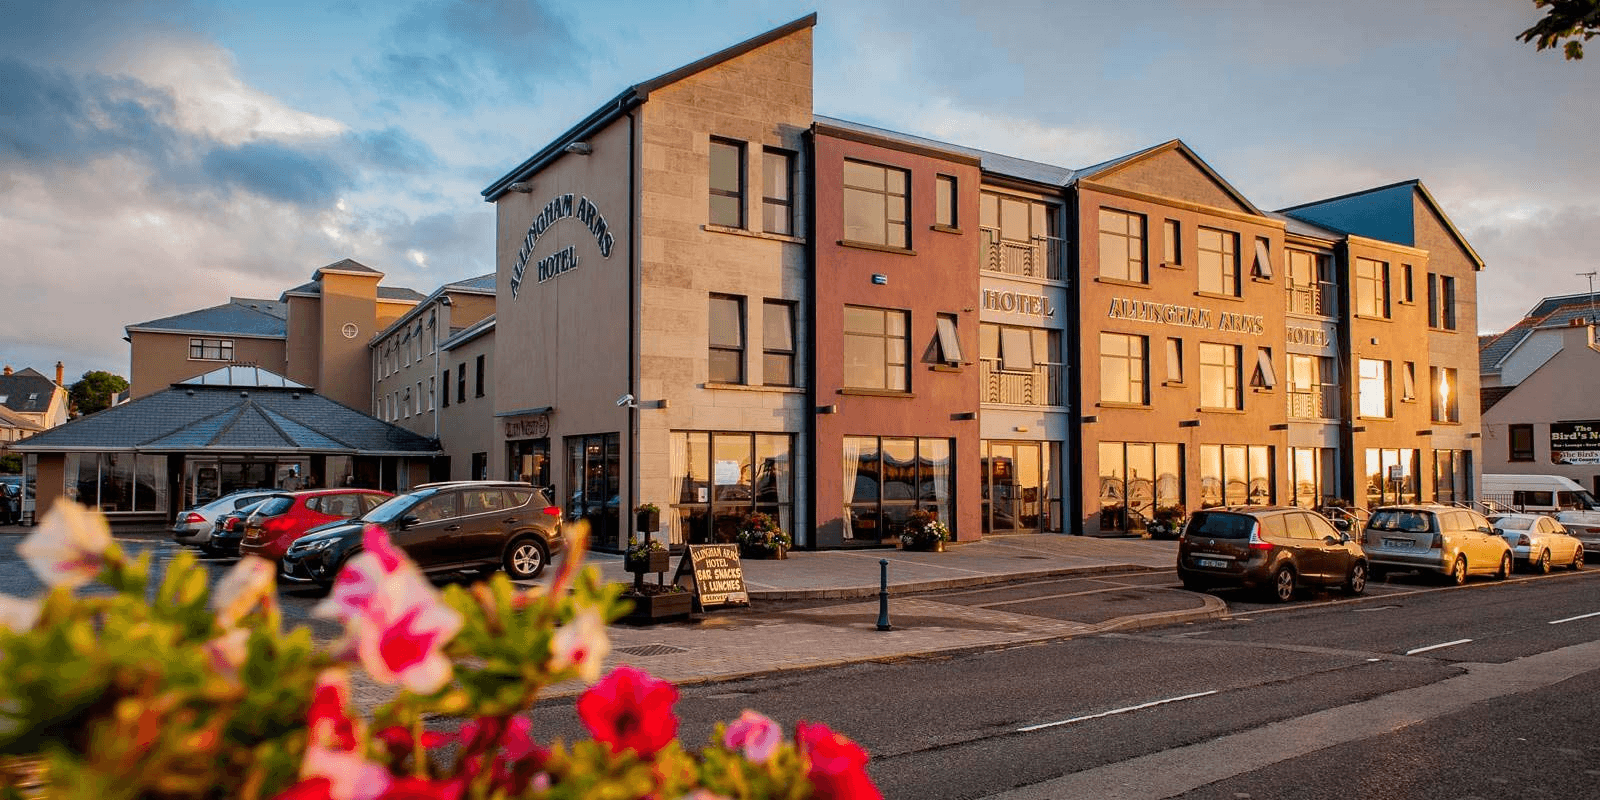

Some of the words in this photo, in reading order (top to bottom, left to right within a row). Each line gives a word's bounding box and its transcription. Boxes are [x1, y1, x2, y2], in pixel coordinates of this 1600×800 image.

[511, 193, 575, 302] ALLINGHAM
[576, 196, 615, 259] ARMS
[537, 245, 579, 284] HOTEL
[983, 288, 1055, 319] HOTEL
[1109, 297, 1214, 330] ALLINGHAM
[1219, 311, 1264, 336] ARMS
[1551, 432, 1588, 440] Bird's
[692, 547, 722, 561] ALLINGHAM
[723, 548, 739, 560] ARMS
[706, 558, 729, 567] HOTEL
[697, 569, 712, 580] BAR
[714, 568, 741, 579] SNACKS
[709, 580, 740, 591] LUNCHES
